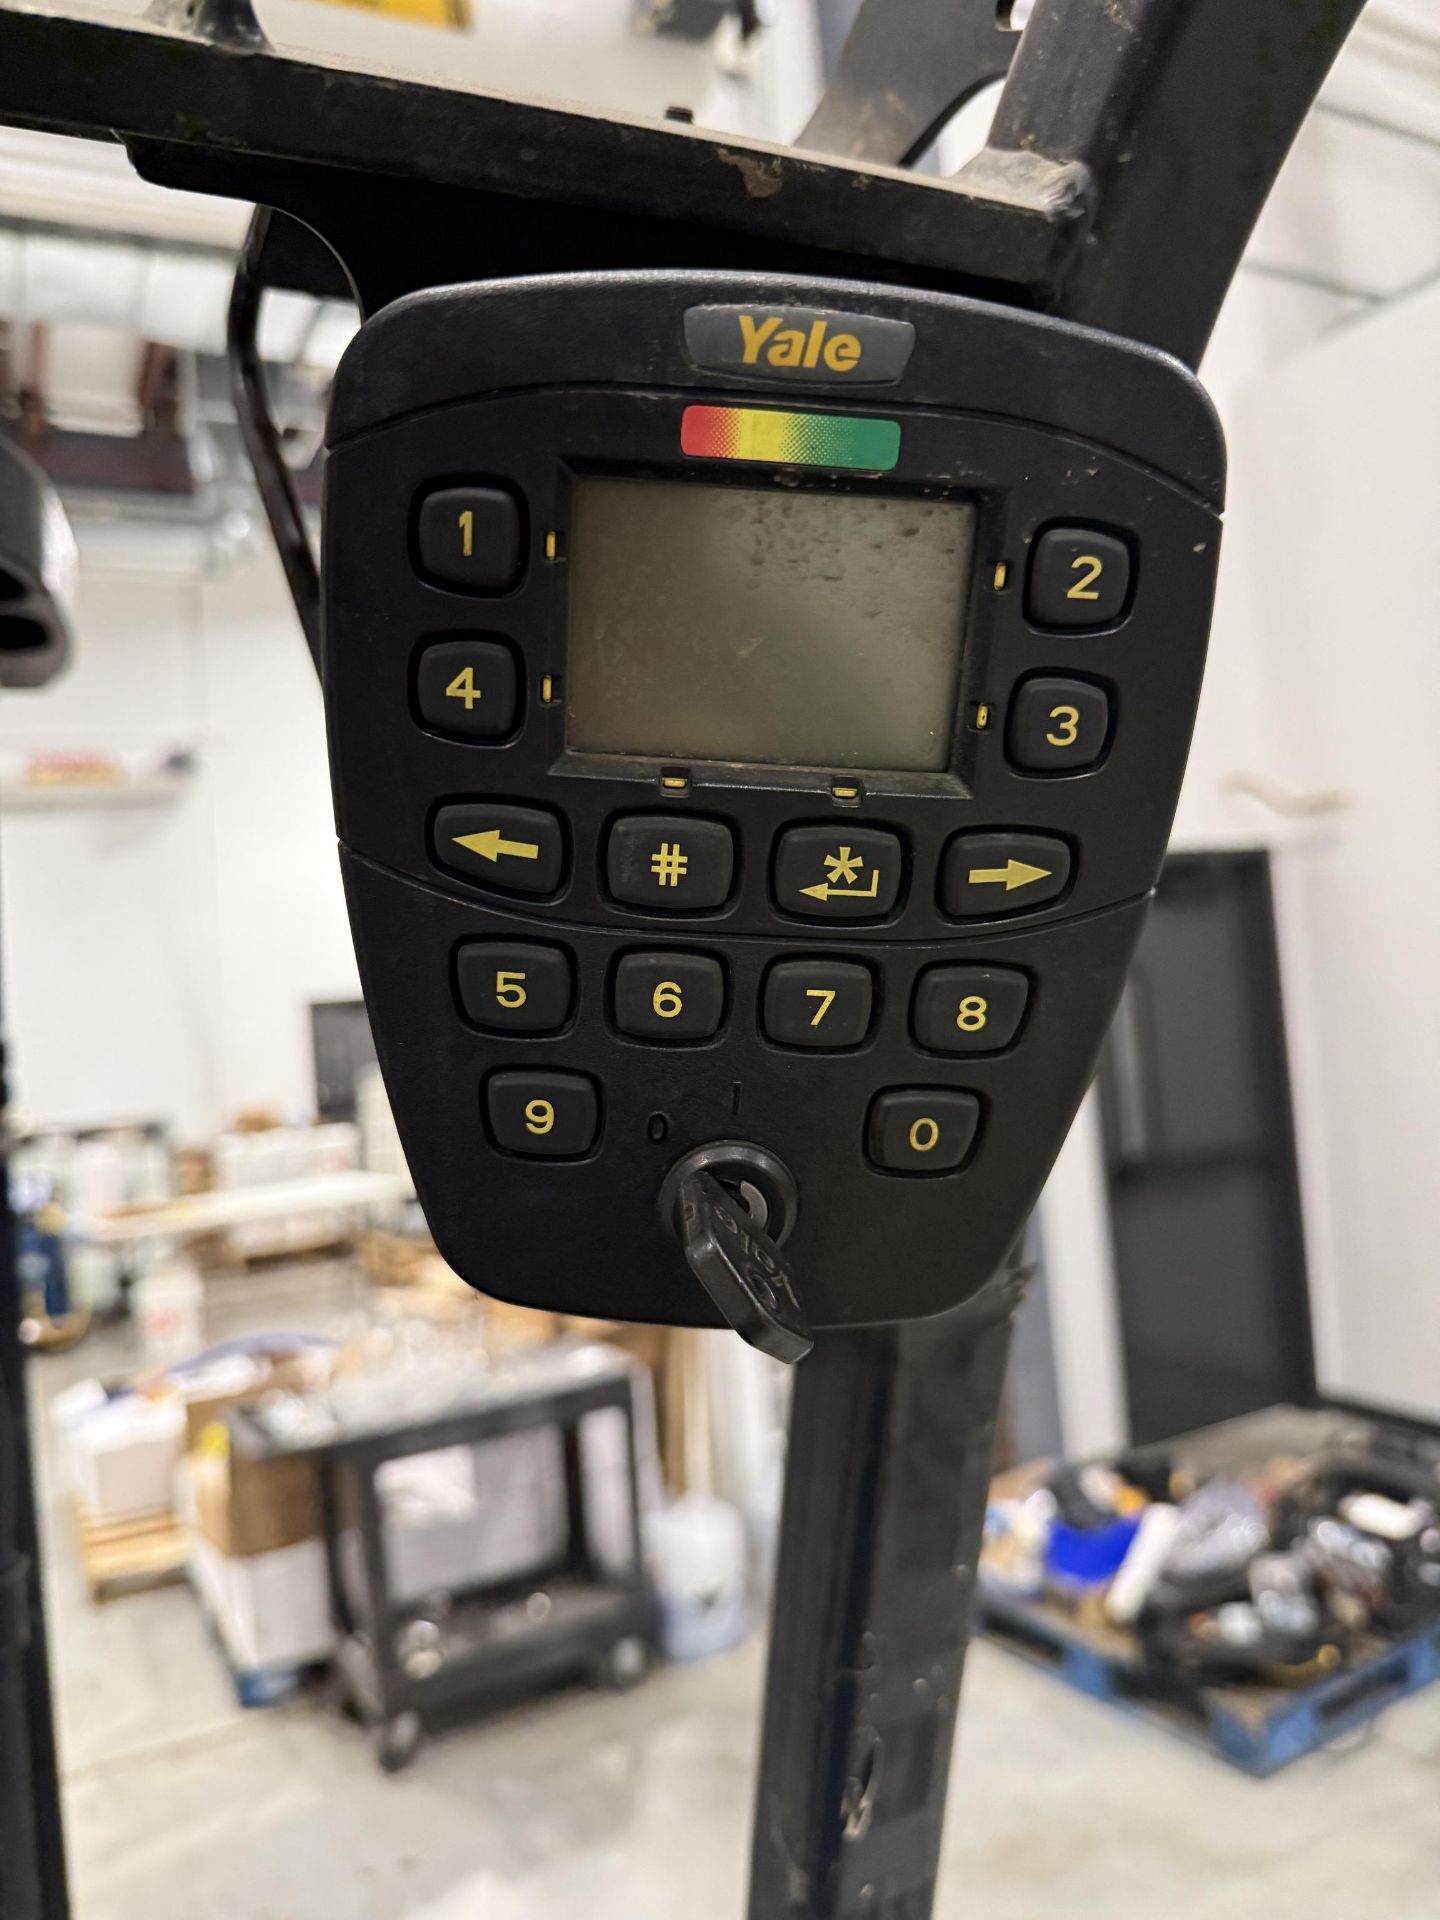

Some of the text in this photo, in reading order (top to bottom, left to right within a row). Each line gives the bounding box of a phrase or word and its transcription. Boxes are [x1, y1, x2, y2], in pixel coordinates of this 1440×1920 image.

[739, 314, 861, 372] Yale
[458, 510, 473, 557] 1
[1066, 556, 1103, 600] 2
[446, 666, 482, 710] 4
[1045, 706, 1080, 747] 3
[496, 971, 527, 1009] 5
[652, 981, 683, 1018] 6
[805, 989, 836, 1026] 7
[956, 995, 988, 1032] 8
[525, 1099, 555, 1135] 9
[909, 1117, 939, 1151] 0
